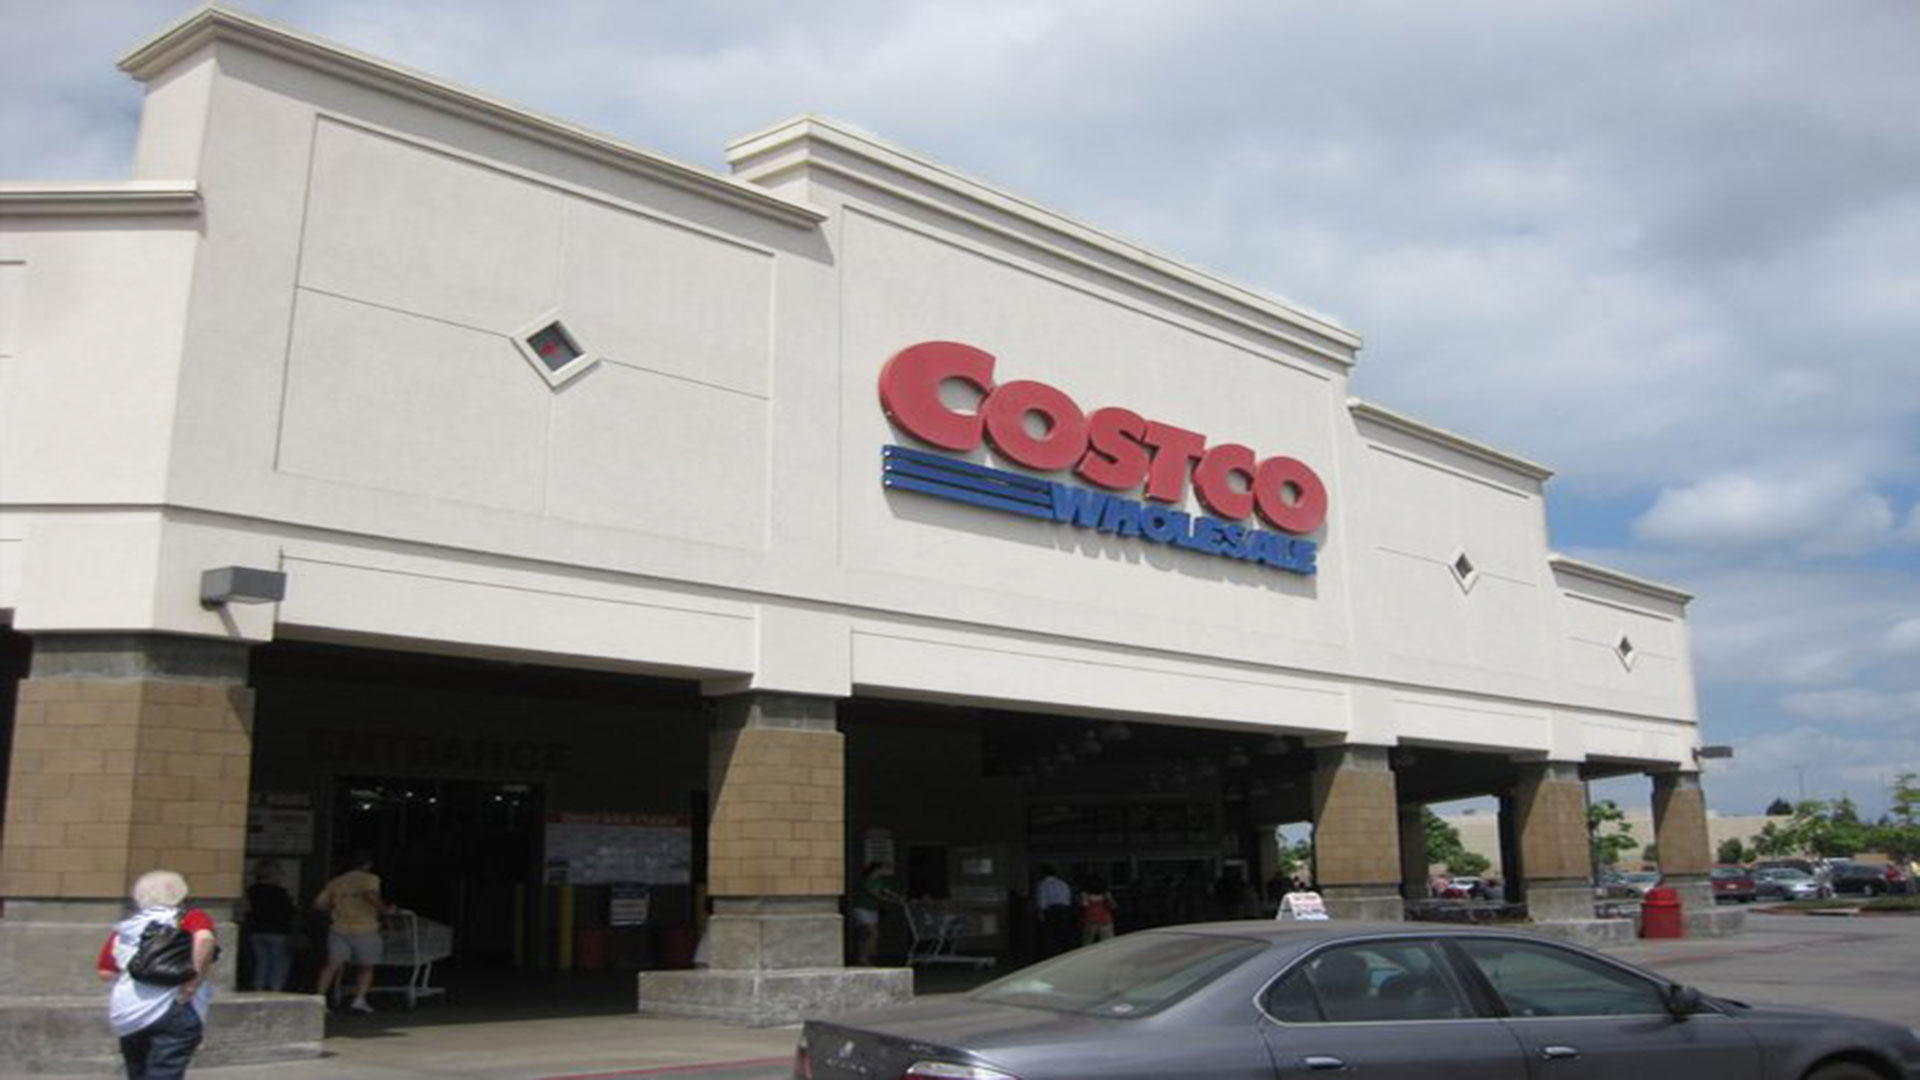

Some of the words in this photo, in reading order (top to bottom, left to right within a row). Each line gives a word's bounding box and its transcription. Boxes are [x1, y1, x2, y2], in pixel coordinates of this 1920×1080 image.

[878, 340, 1328, 535] COSTCO
[1050, 482, 1318, 575] WHOLESALE
[306, 728, 572, 772] ENTRANCE
